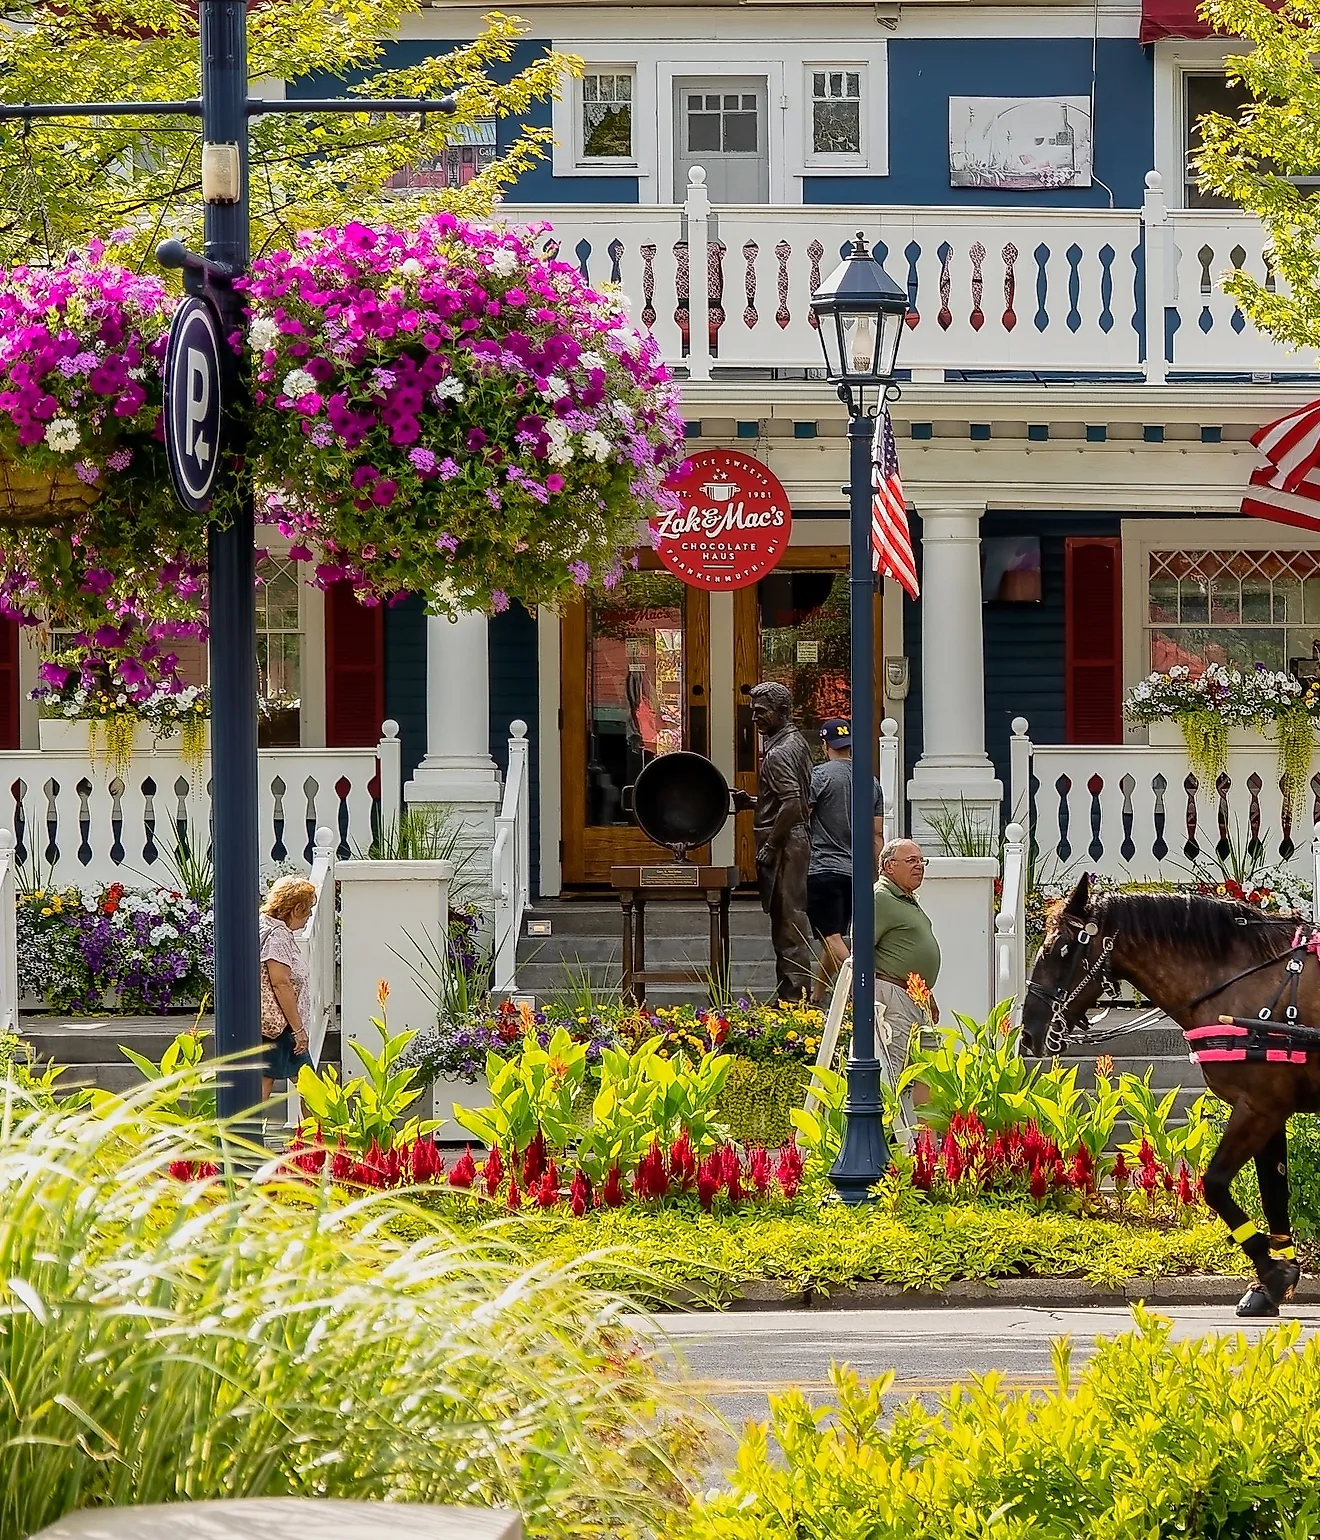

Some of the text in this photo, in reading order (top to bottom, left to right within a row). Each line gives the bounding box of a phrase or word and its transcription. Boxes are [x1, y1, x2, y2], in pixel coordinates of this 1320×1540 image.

[185, 347, 210, 457] P
[725, 458, 768, 485] SWEETS
[675, 490, 772, 499] ST. 1981
[681, 542, 757, 551] CHOCOLATE
[702, 552, 736, 561] HAUS
